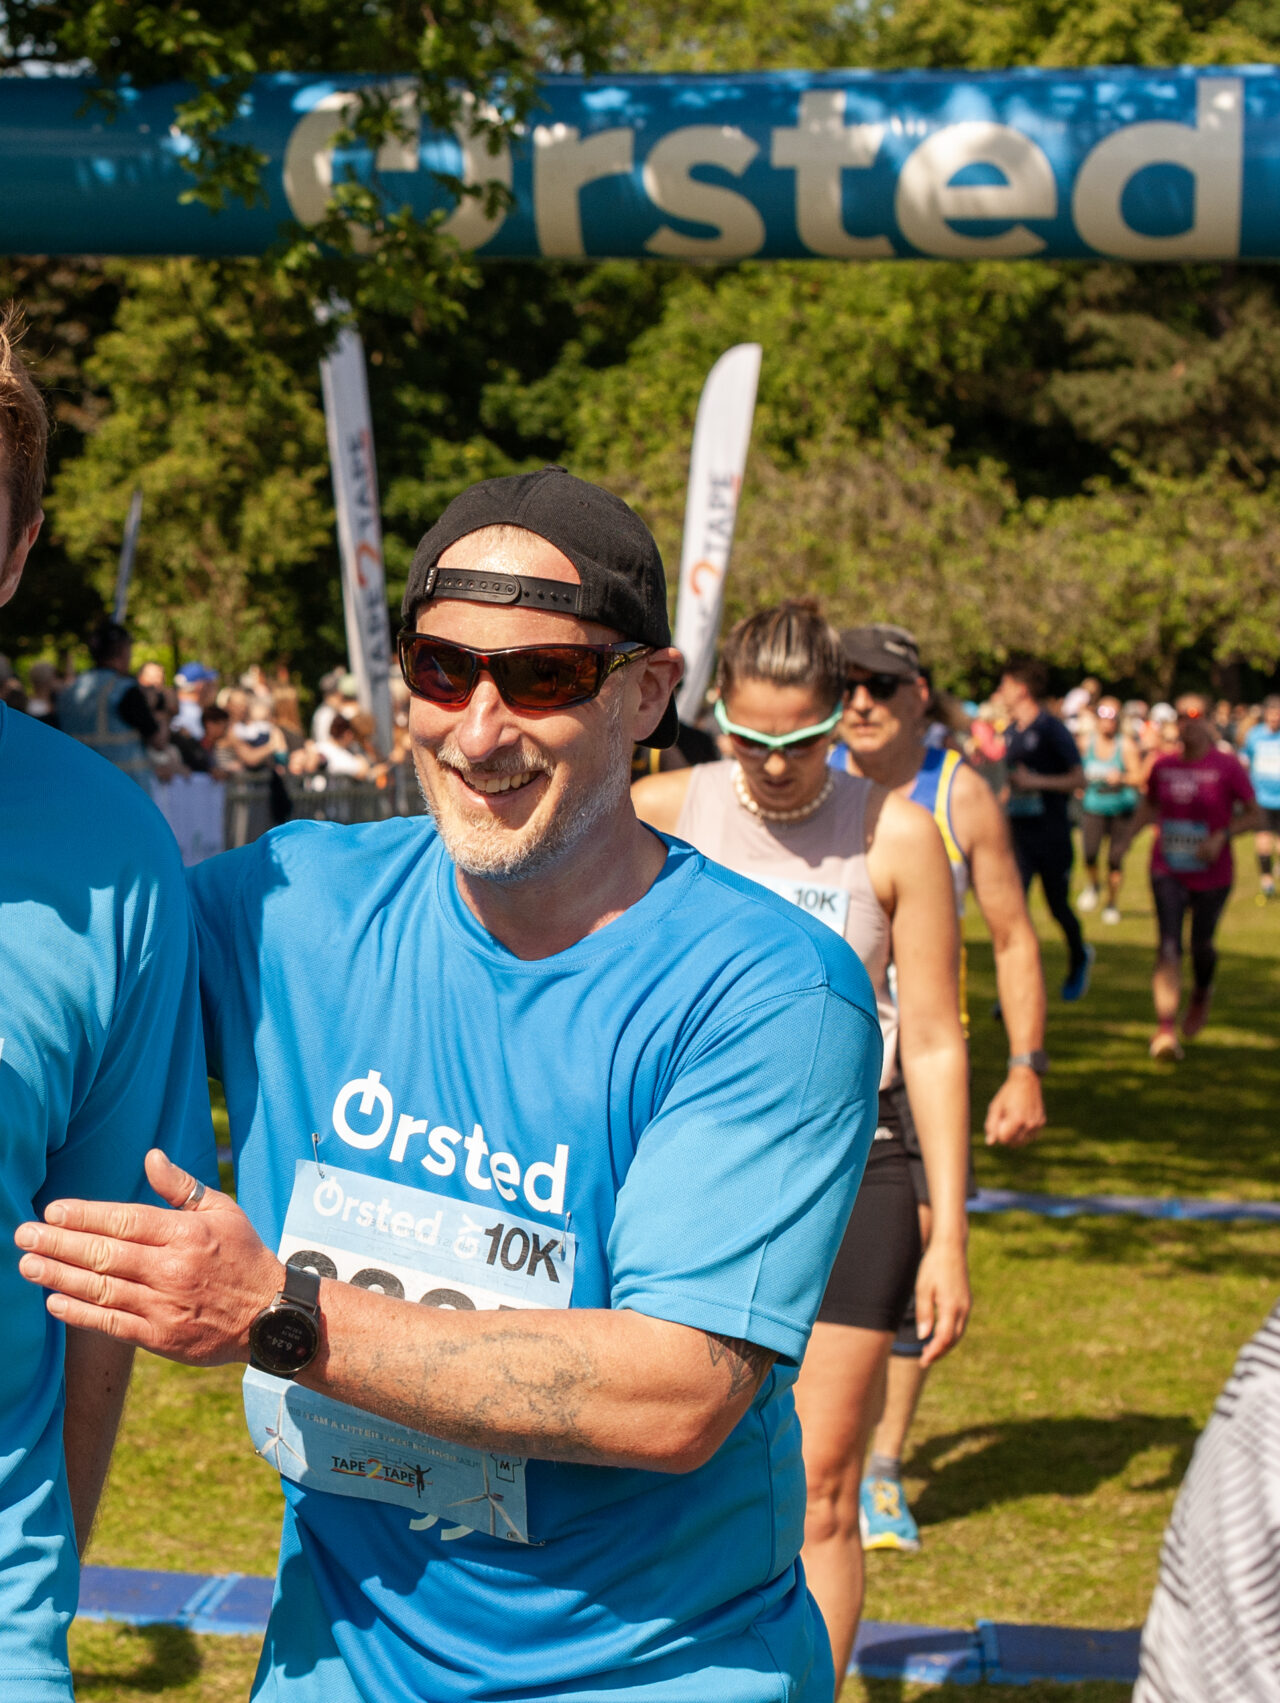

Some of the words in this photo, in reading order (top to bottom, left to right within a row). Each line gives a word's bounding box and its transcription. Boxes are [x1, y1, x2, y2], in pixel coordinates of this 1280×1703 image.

[284, 78, 1244, 259] Ørsted
[794, 887, 838, 913] 10K
[332, 1069, 569, 1215] Ørsted
[313, 1176, 443, 1246] Ørsted
[453, 1213, 484, 1260] GY
[484, 1222, 561, 1284] 10K
[331, 1419, 338, 1429] A
[341, 1421, 379, 1439] LITTER
[499, 1460, 511, 1471] M
